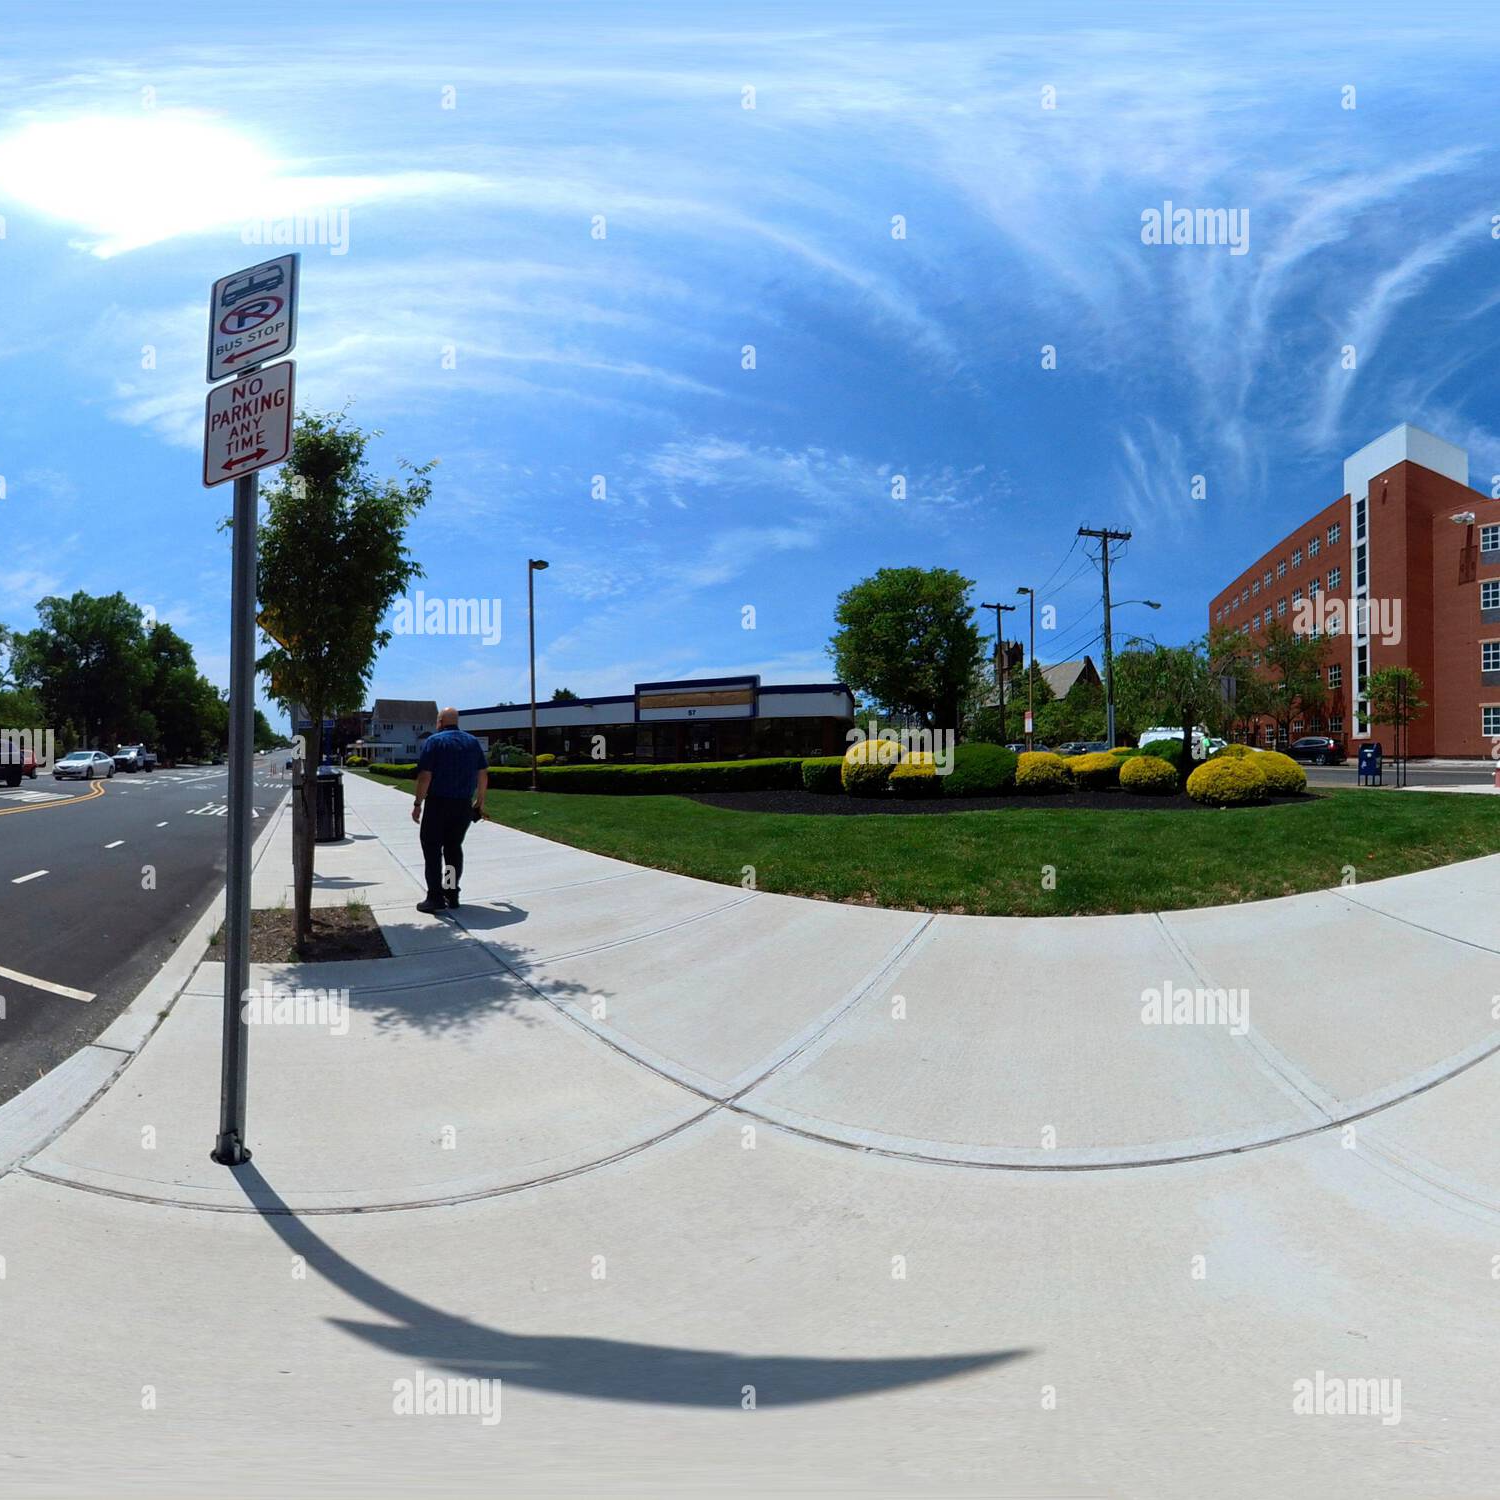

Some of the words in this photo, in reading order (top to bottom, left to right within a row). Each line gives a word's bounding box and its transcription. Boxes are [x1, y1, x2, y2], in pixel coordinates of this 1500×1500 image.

[216, 339, 243, 356] BUS
[247, 321, 285, 343] STOP
[231, 378, 263, 403] NO
[211, 388, 285, 432] PARKING
[228, 415, 263, 440] ANY
[225, 430, 266, 456] TIME
